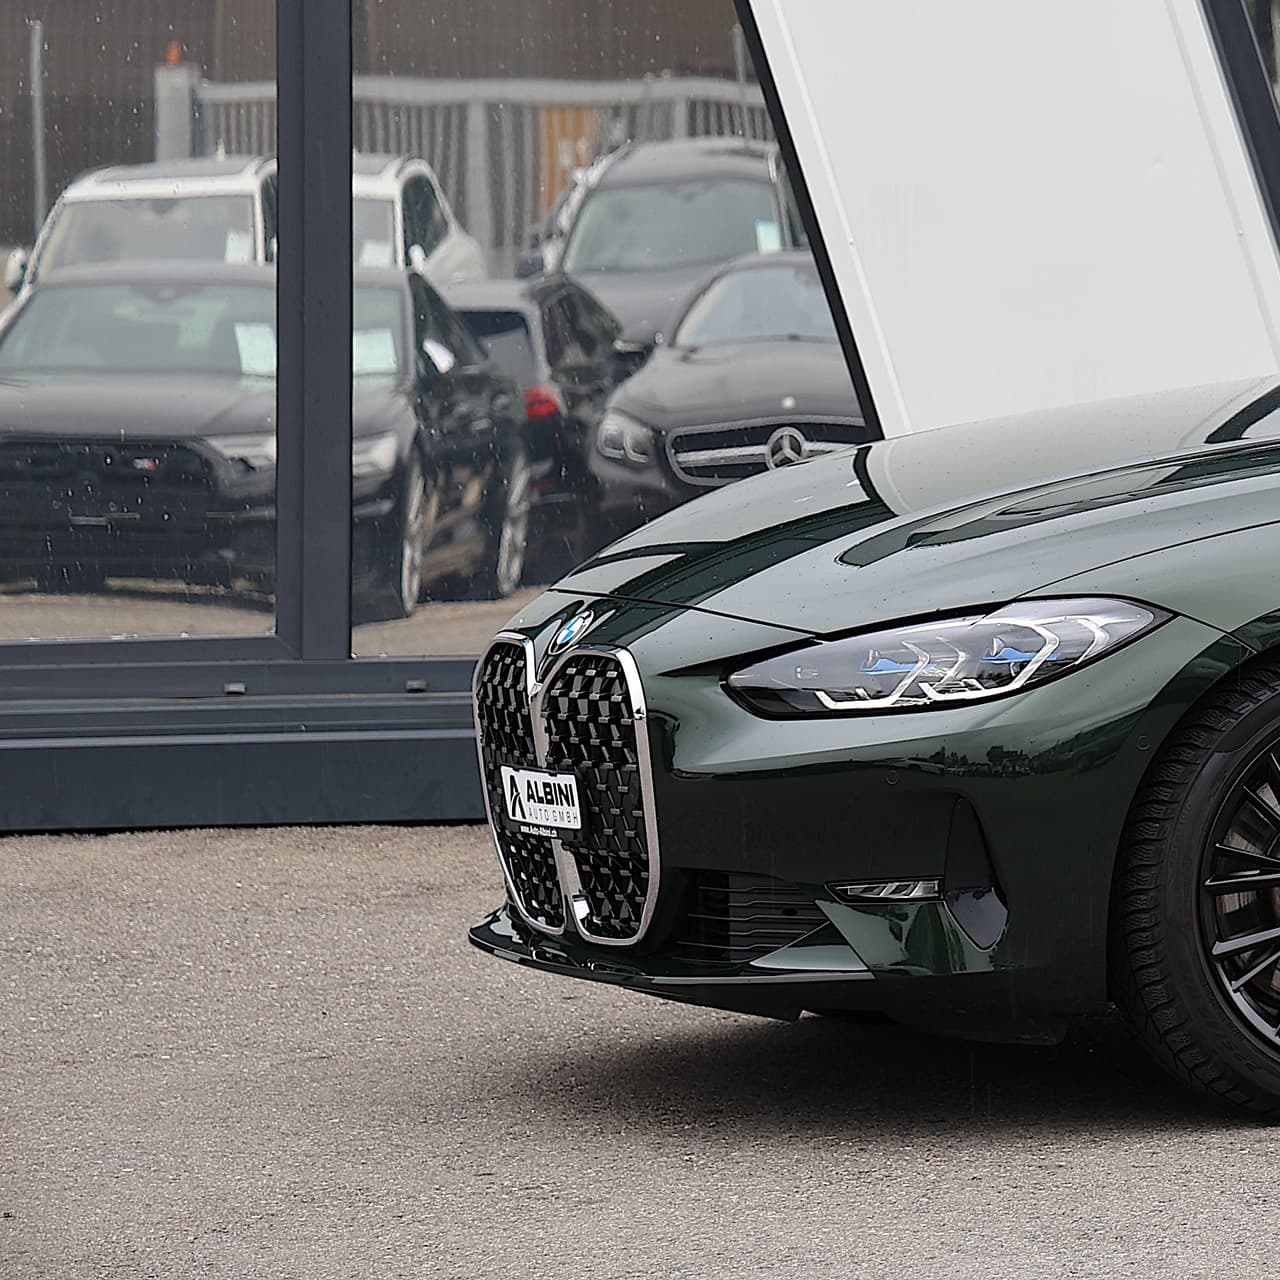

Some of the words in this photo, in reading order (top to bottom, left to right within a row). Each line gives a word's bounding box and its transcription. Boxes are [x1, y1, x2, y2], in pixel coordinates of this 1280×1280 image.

[526, 779, 576, 807] ALBINI
[528, 808, 550, 821] AUTO
[553, 809, 578, 825] GMBH
